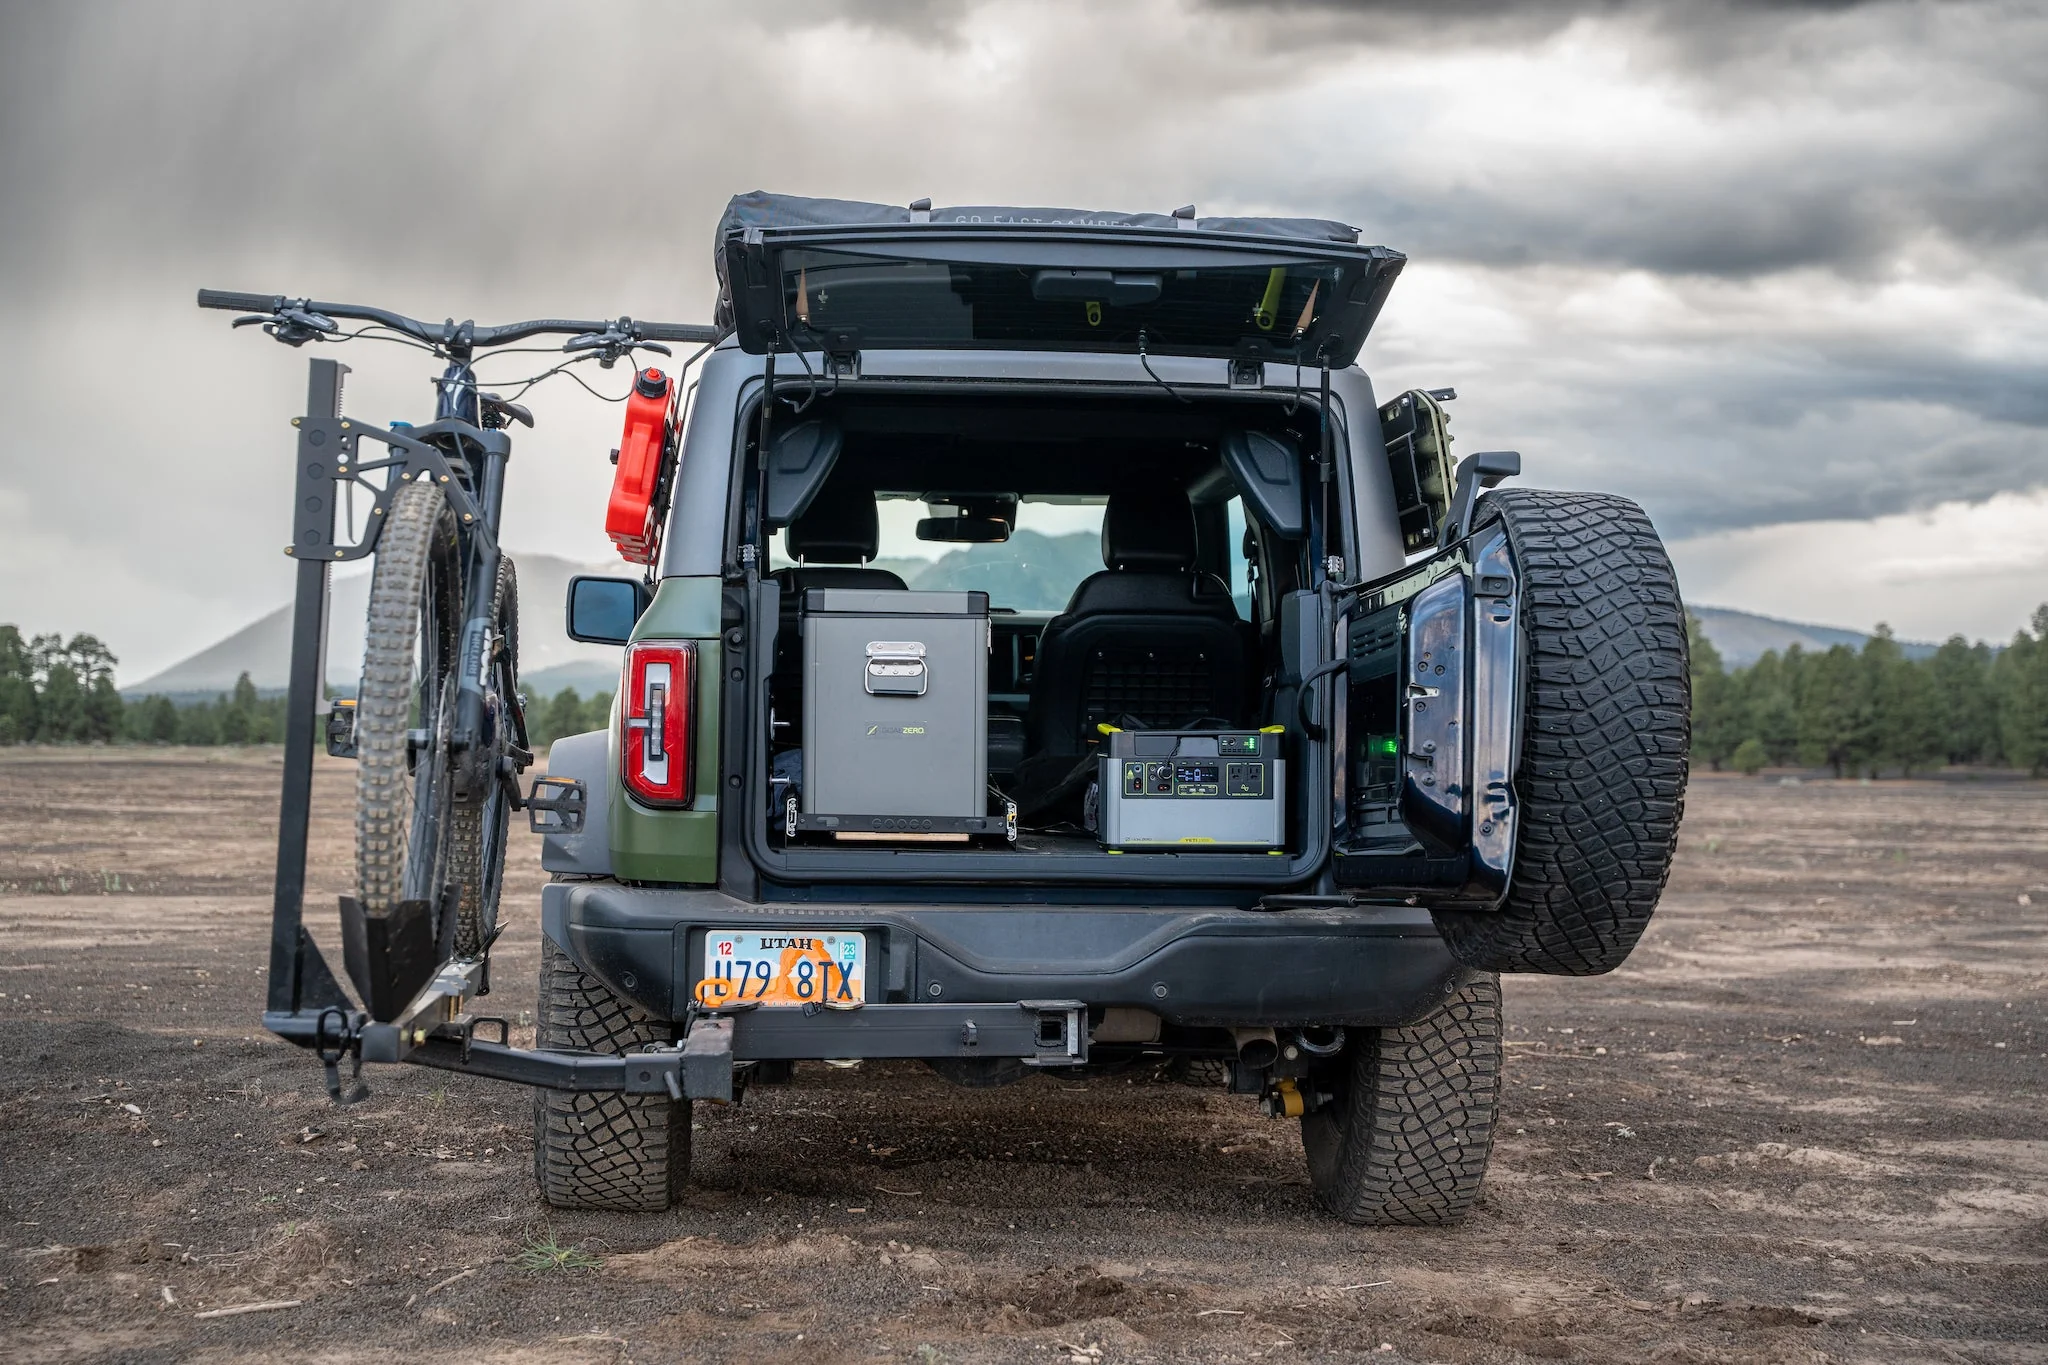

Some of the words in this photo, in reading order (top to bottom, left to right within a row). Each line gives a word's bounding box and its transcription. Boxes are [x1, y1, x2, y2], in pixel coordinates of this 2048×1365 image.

[468, 633, 480, 676] RHYTHM
[718, 942, 732, 955] 12
[760, 937, 813, 950] UTAH
[844, 944, 855, 955] 23
[715, 960, 771, 998] U79
[797, 960, 853, 999] 8TX
